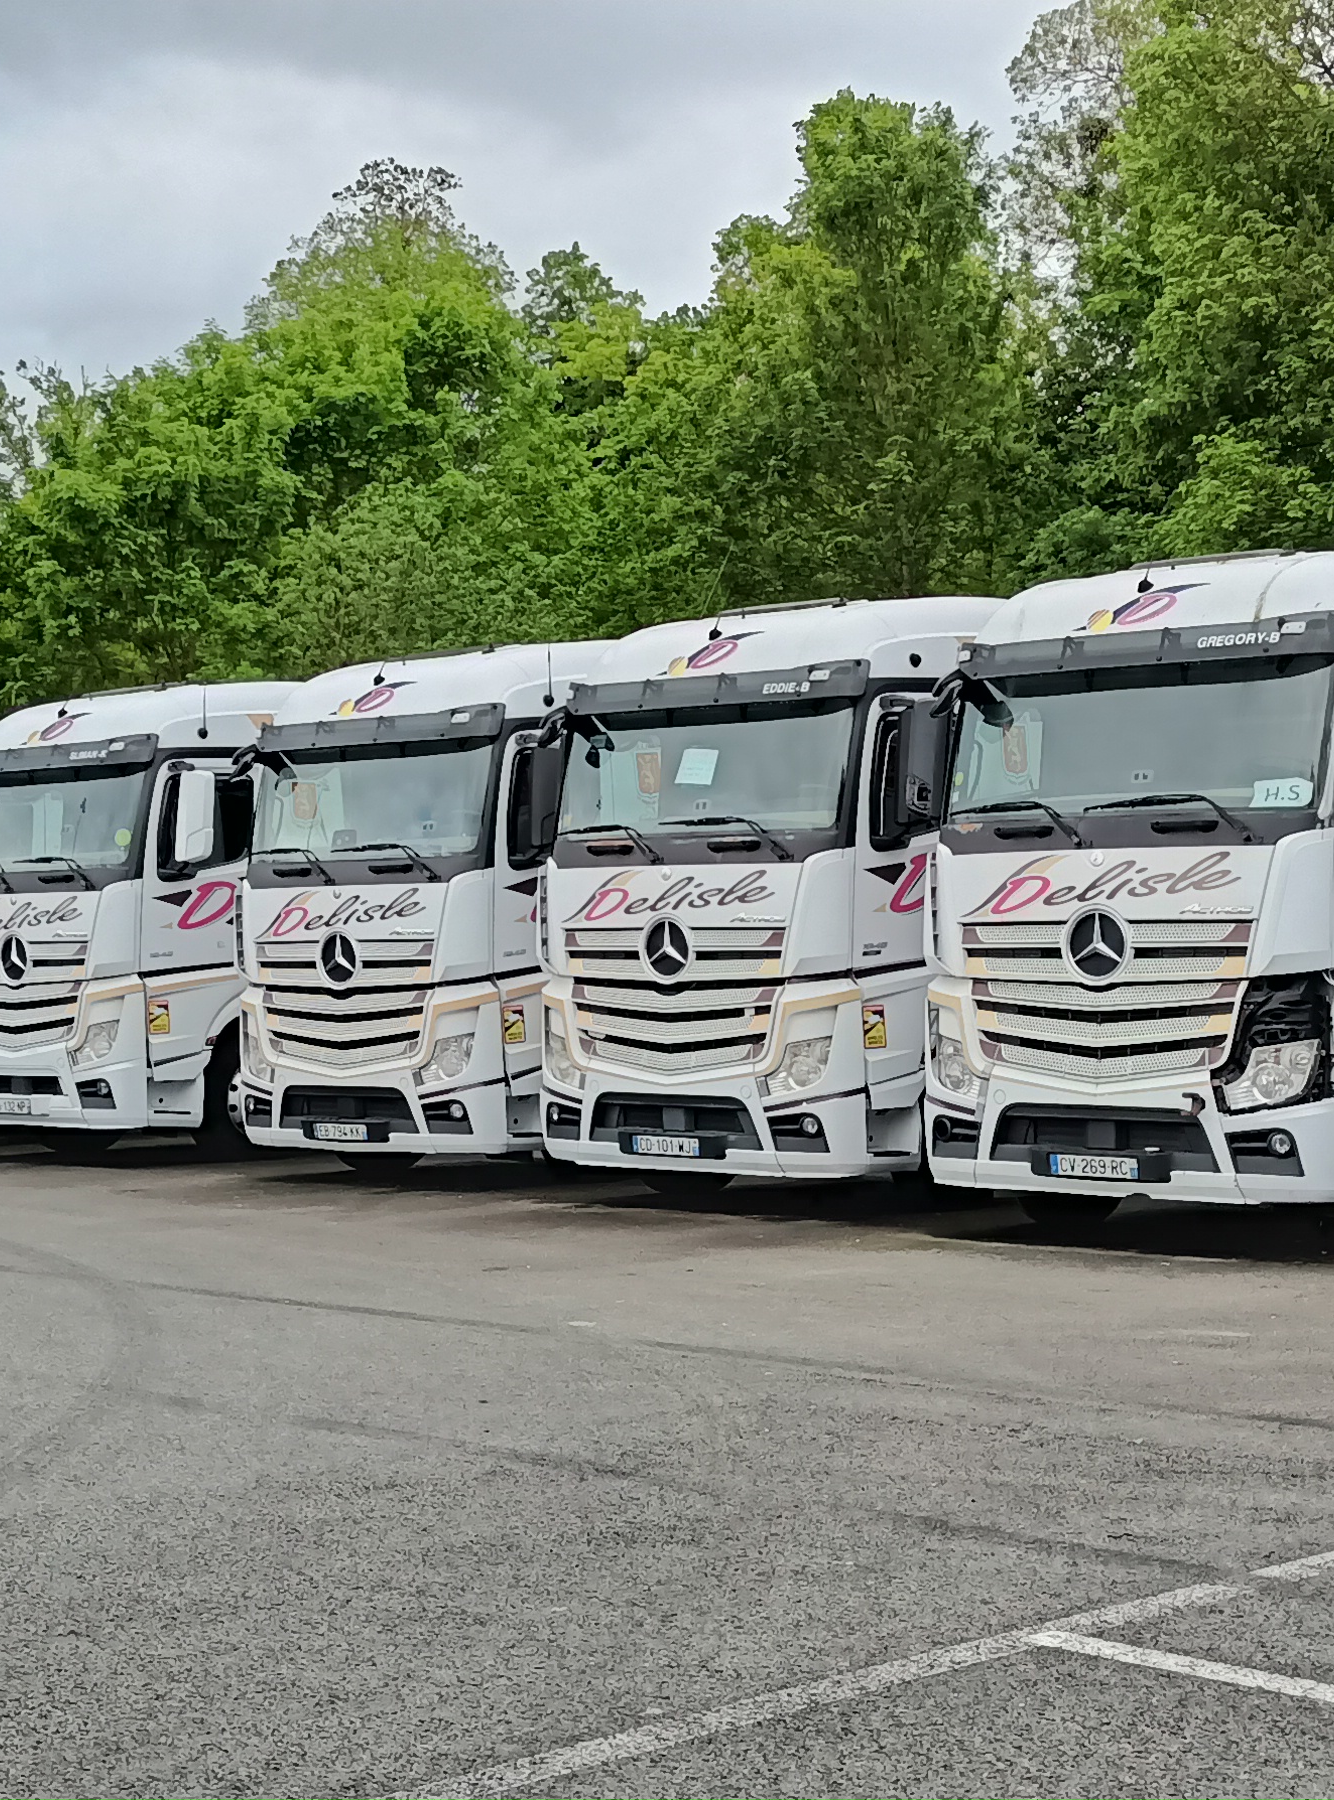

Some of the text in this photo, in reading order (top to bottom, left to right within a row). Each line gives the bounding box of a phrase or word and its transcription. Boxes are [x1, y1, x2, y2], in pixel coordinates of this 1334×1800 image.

[1196, 631, 1281, 649] GREGORY-B
[762, 681, 811, 695] EDDIE-B
[989, 851, 1242, 915] Delisle
[583, 869, 775, 922] Delisle
[272, 887, 427, 938] Delisle
[638, 1137, 692, 1154] CD-101-WJ
[1058, 1156, 1129, 1176] CV-269-RC
